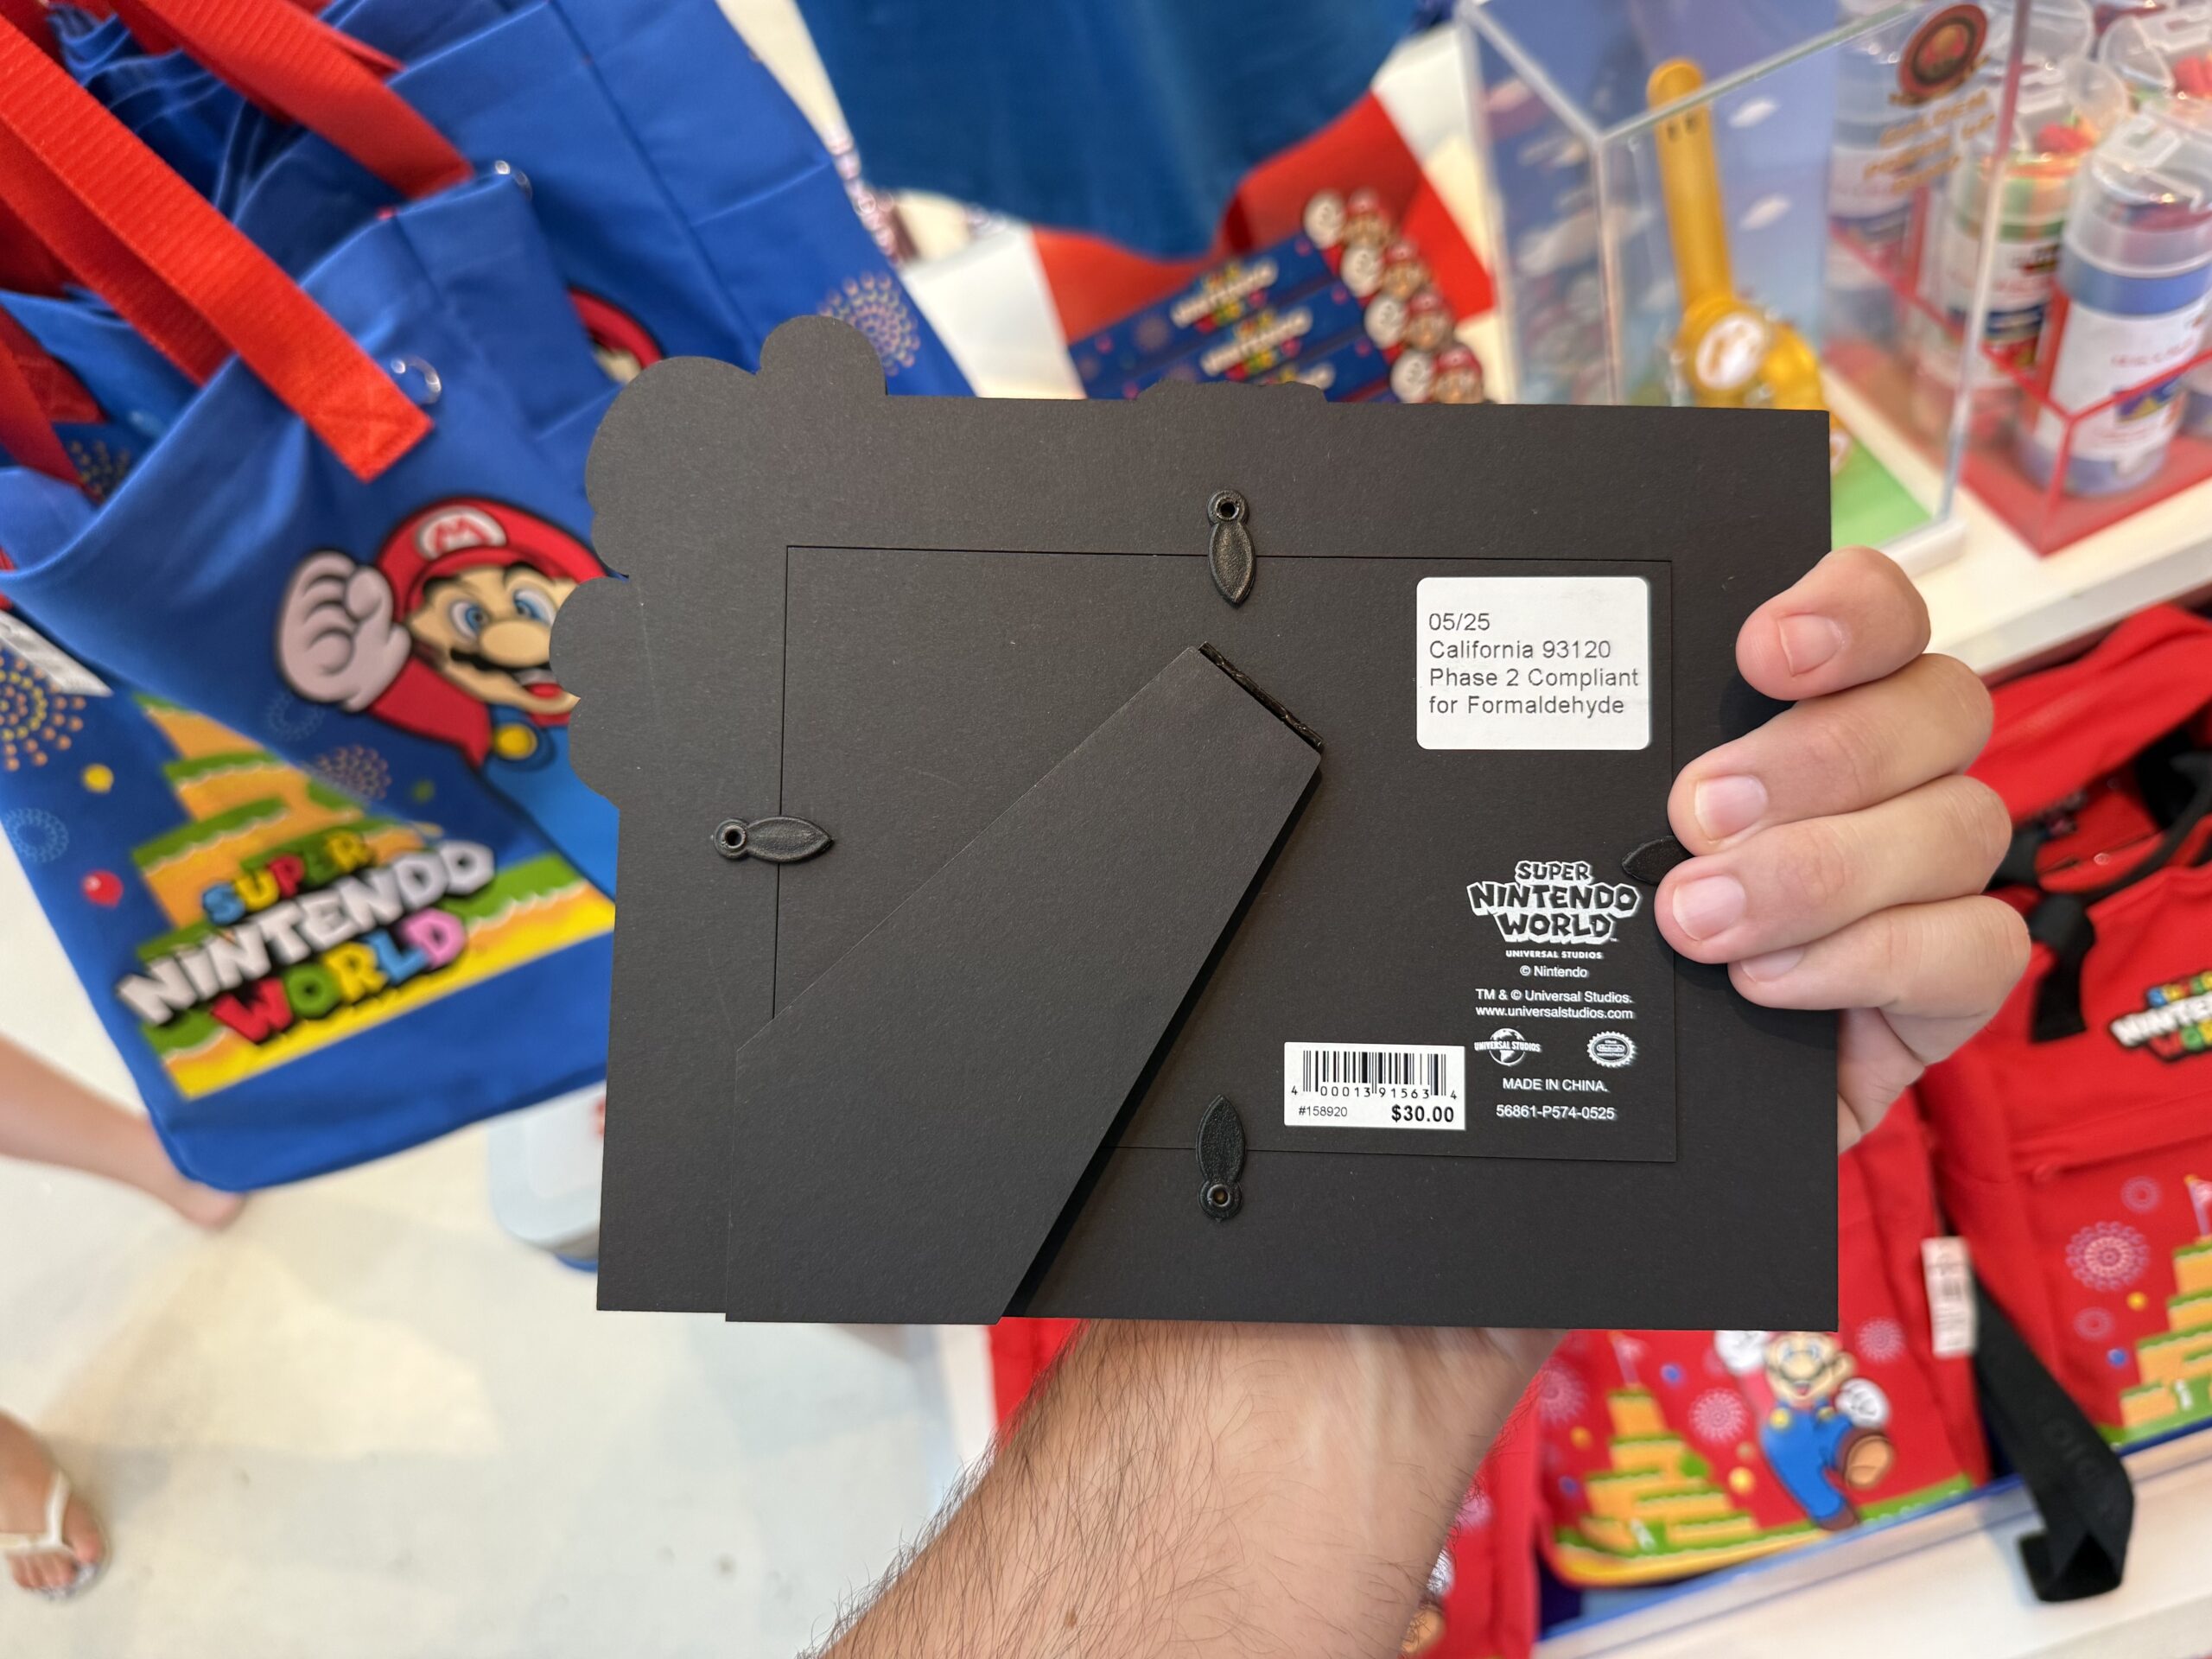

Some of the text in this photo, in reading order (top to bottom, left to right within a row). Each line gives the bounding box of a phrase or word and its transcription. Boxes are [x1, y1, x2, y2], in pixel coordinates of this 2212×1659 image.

[1428, 613, 1491, 632] 05/25
[1428, 639, 1611, 660] California 93120
[1429, 668, 1639, 692] Phase 2 Compliant
[1428, 696, 1624, 719] for Formaldehyde
[201, 829, 374, 925] SUPER
[1516, 861, 1593, 883] SUPER
[1466, 882, 1640, 917] NINTENDO
[117, 840, 495, 1026] NINTENDO
[1495, 912, 1614, 943] WORLD
[1505, 950, 1604, 960] UNIVERSAL STUDIOS
[212, 908, 468, 1044] WORLD
[1534, 964, 1588, 978] Nintendo
[1475, 988, 1496, 1001] TM
[1498, 989, 1509, 1001] &
[1524, 989, 1581, 1002] Universal
[1584, 990, 1633, 1004] Studios.
[1475, 1006, 1635, 1020] www.universalstudios.com
[1474, 1041, 1542, 1052] UNIVERSAL STUDIOS
[1502, 1077, 1609, 1092] MADE IN CHINA.
[1298, 1103, 1454, 1122] #158920 $30.00
[1496, 1103, 1617, 1120] 56861-P574-0525
